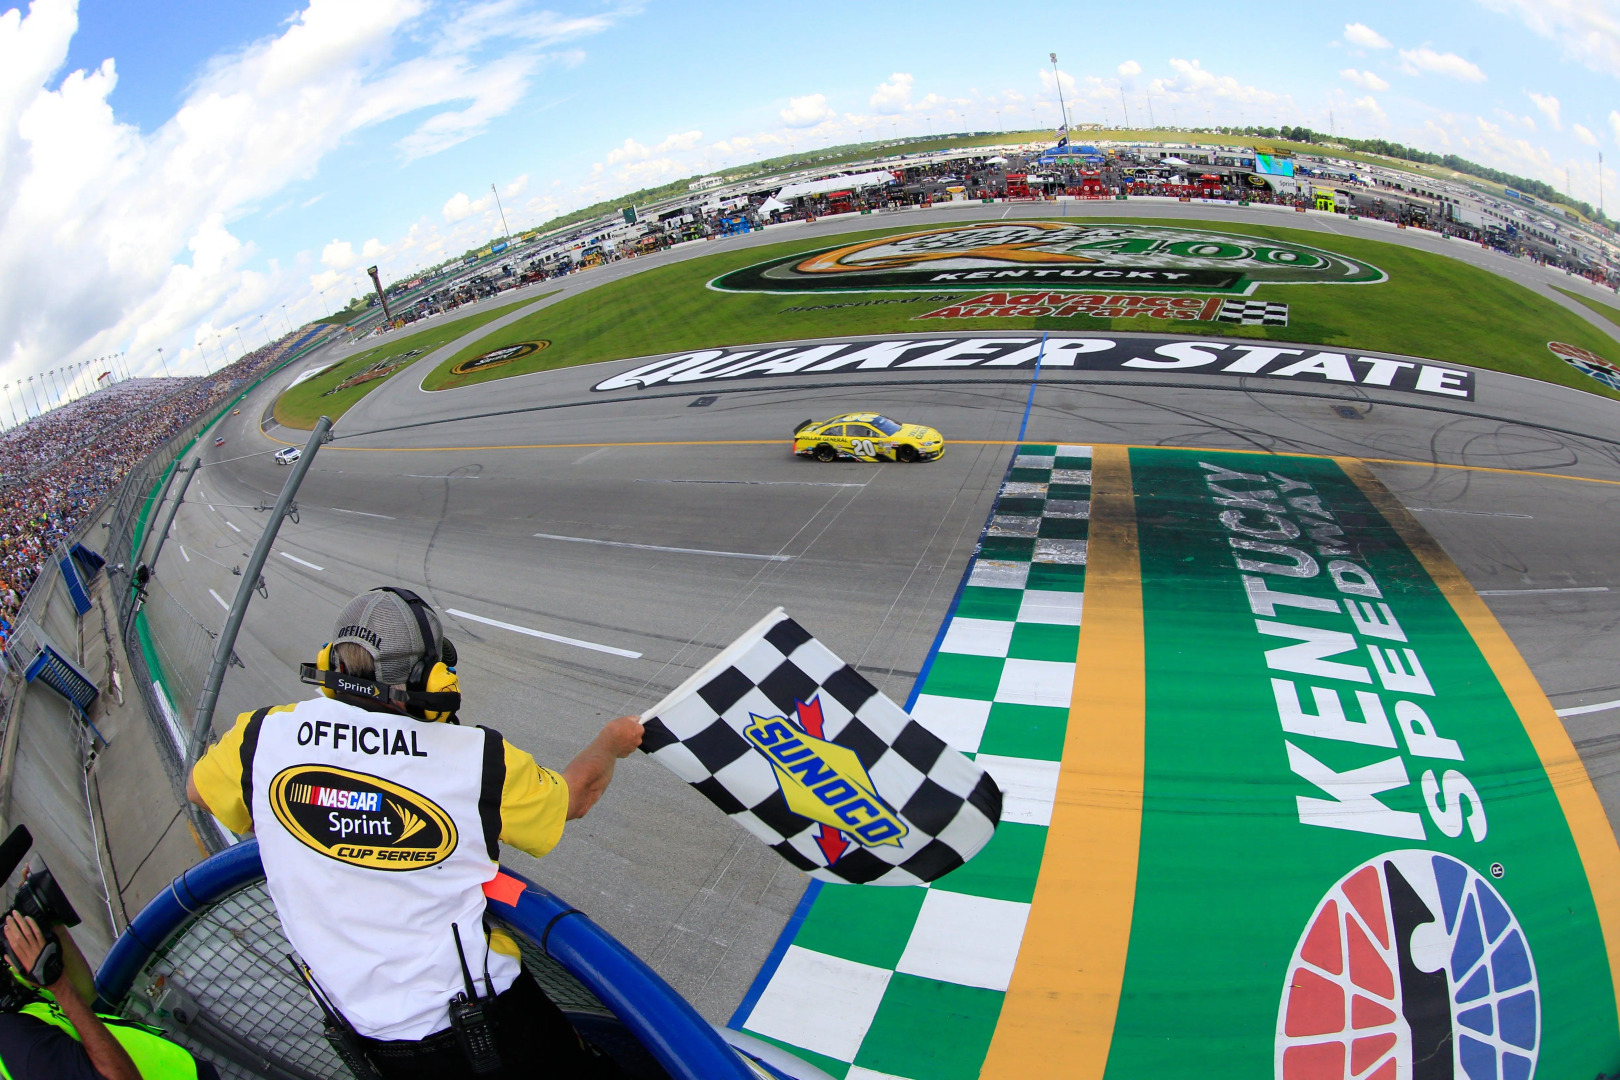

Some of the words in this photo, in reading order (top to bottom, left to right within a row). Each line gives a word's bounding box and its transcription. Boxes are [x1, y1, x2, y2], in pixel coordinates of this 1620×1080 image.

[1066, 237, 1331, 270] 400
[930, 269, 1190, 282] KENTUCKY
[910, 304, 1056, 320] Auto
[1050, 304, 1201, 320] Parts
[948, 292, 1205, 308] Advance
[594, 338, 1117, 390] QUAKER
[1120, 341, 1468, 397] STATE
[851, 439, 877, 457] 20
[338, 625, 383, 651] OFFICIAL
[1198, 461, 1427, 841] KENTUCKY
[1268, 471, 1488, 843] SPEEDWAY
[338, 678, 373, 695] Sprint
[297, 721, 428, 757] OFFICIAL
[750, 720, 902, 845] SUNOCO
[317, 786, 379, 812] NASCAR
[329, 812, 392, 838] Sprint
[337, 847, 374, 860] CUP
[376, 849, 438, 862] SERIES
